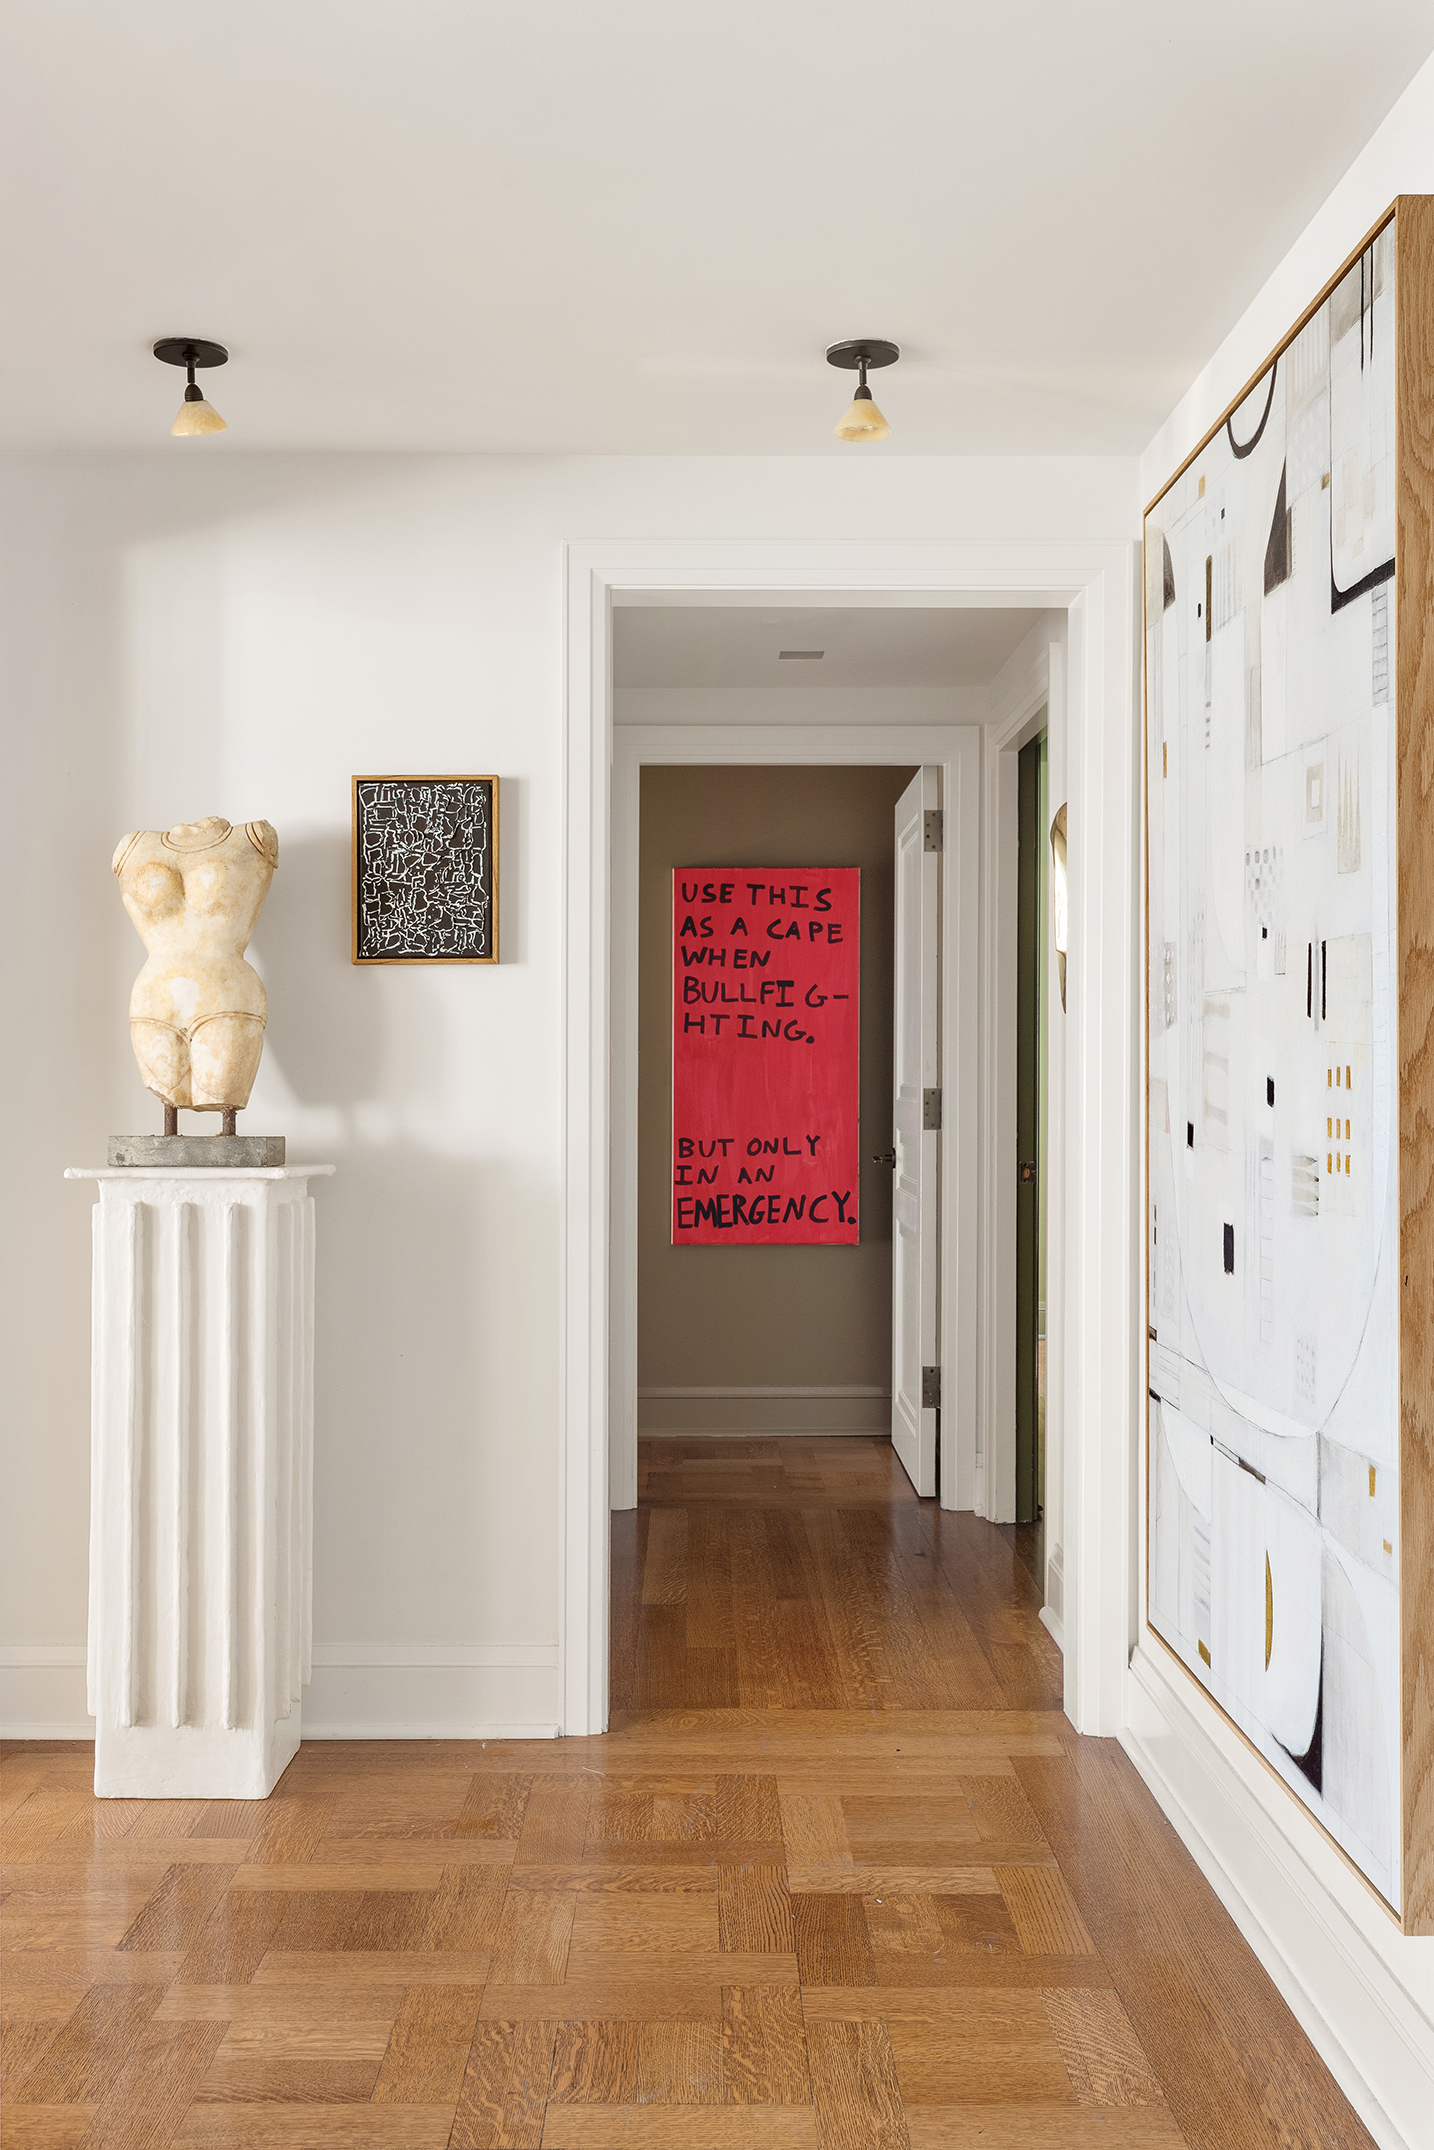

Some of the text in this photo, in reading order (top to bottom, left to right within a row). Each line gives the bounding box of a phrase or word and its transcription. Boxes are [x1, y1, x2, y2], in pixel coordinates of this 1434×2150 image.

[681, 882, 832, 912] USE THIS
[679, 915, 844, 945] AS A CAPE
[680, 945, 771, 969] WHEN
[683, 975, 850, 1008] BULLFIG-
[683, 1012, 815, 1044] HTING.
[678, 1134, 821, 1159] BUT ONLY
[674, 1164, 775, 1186] IN AN
[677, 1190, 857, 1229] EMERGENCY.
